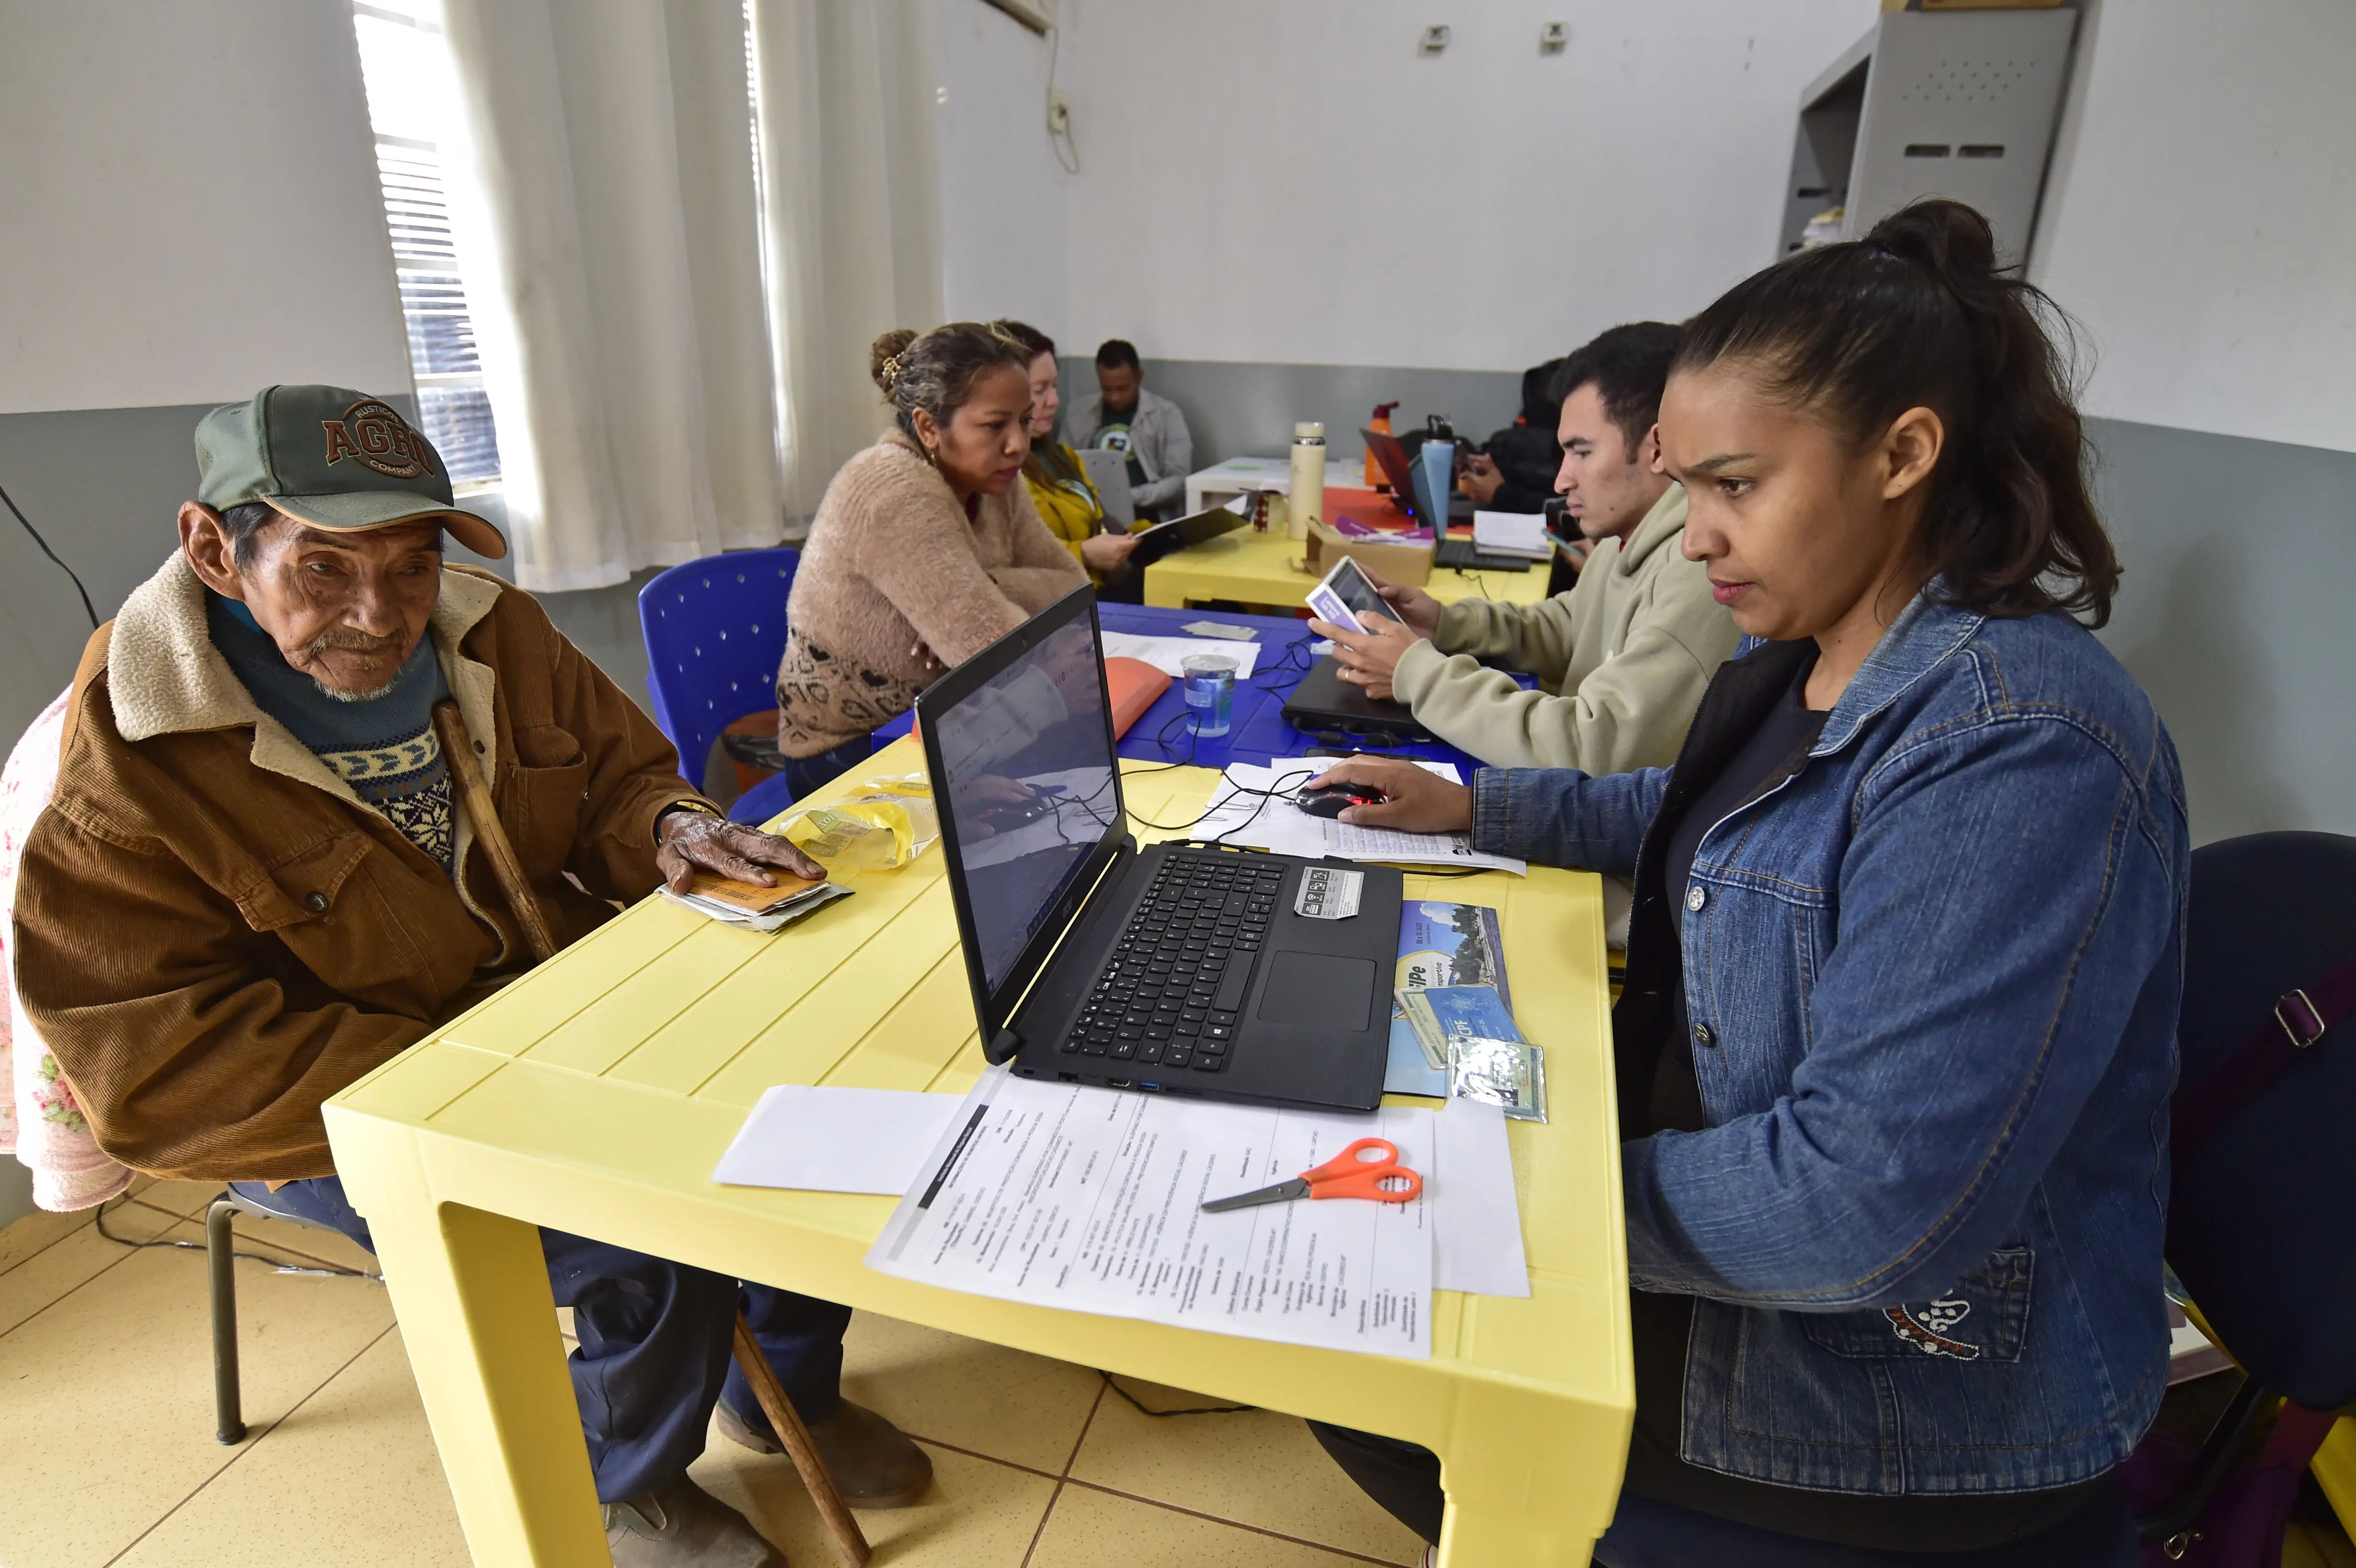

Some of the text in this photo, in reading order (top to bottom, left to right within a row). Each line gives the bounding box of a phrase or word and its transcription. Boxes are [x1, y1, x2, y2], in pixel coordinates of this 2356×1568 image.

[322, 419, 435, 478] AGRO
[369, 460, 416, 475] COMPANY
[1454, 1020, 1473, 1036] CPF
